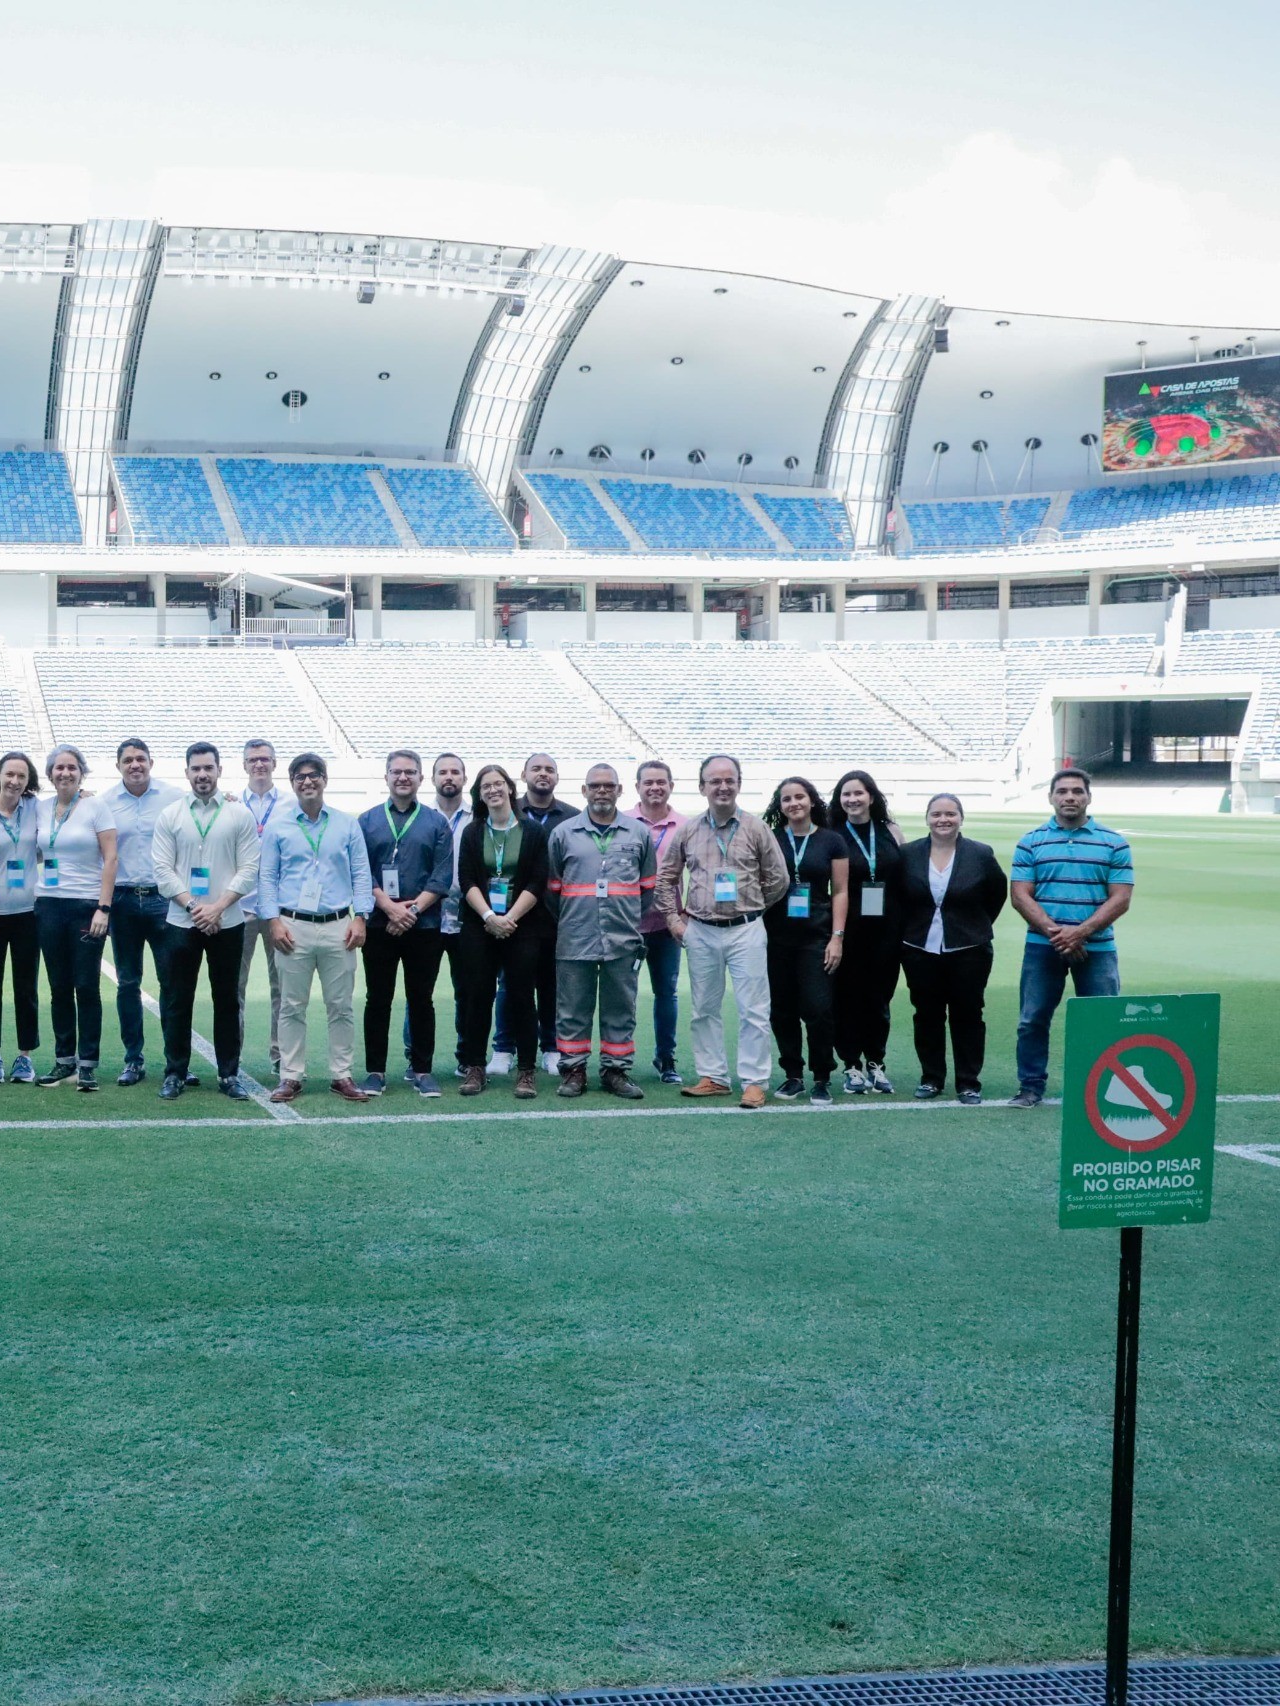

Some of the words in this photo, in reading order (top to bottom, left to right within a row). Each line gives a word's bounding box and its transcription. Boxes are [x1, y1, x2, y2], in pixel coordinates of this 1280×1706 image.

[1160, 384, 1184, 393] CASA
[1184, 382, 1198, 390] DE
[1197, 377, 1240, 388] APOSTAS
[1073, 1161, 1152, 1176] PROIBIDO
[1156, 1158, 1201, 1173] PISAR
[1083, 1178, 1109, 1192] NO
[1112, 1174, 1195, 1191] GRAMADO
[1067, 1194, 1083, 1202] Essa
[1084, 1193, 1113, 1201] conduta
[1114, 1192, 1132, 1201] pode
[1133, 1191, 1162, 1199] danificar
[1169, 1189, 1198, 1198] gramado
